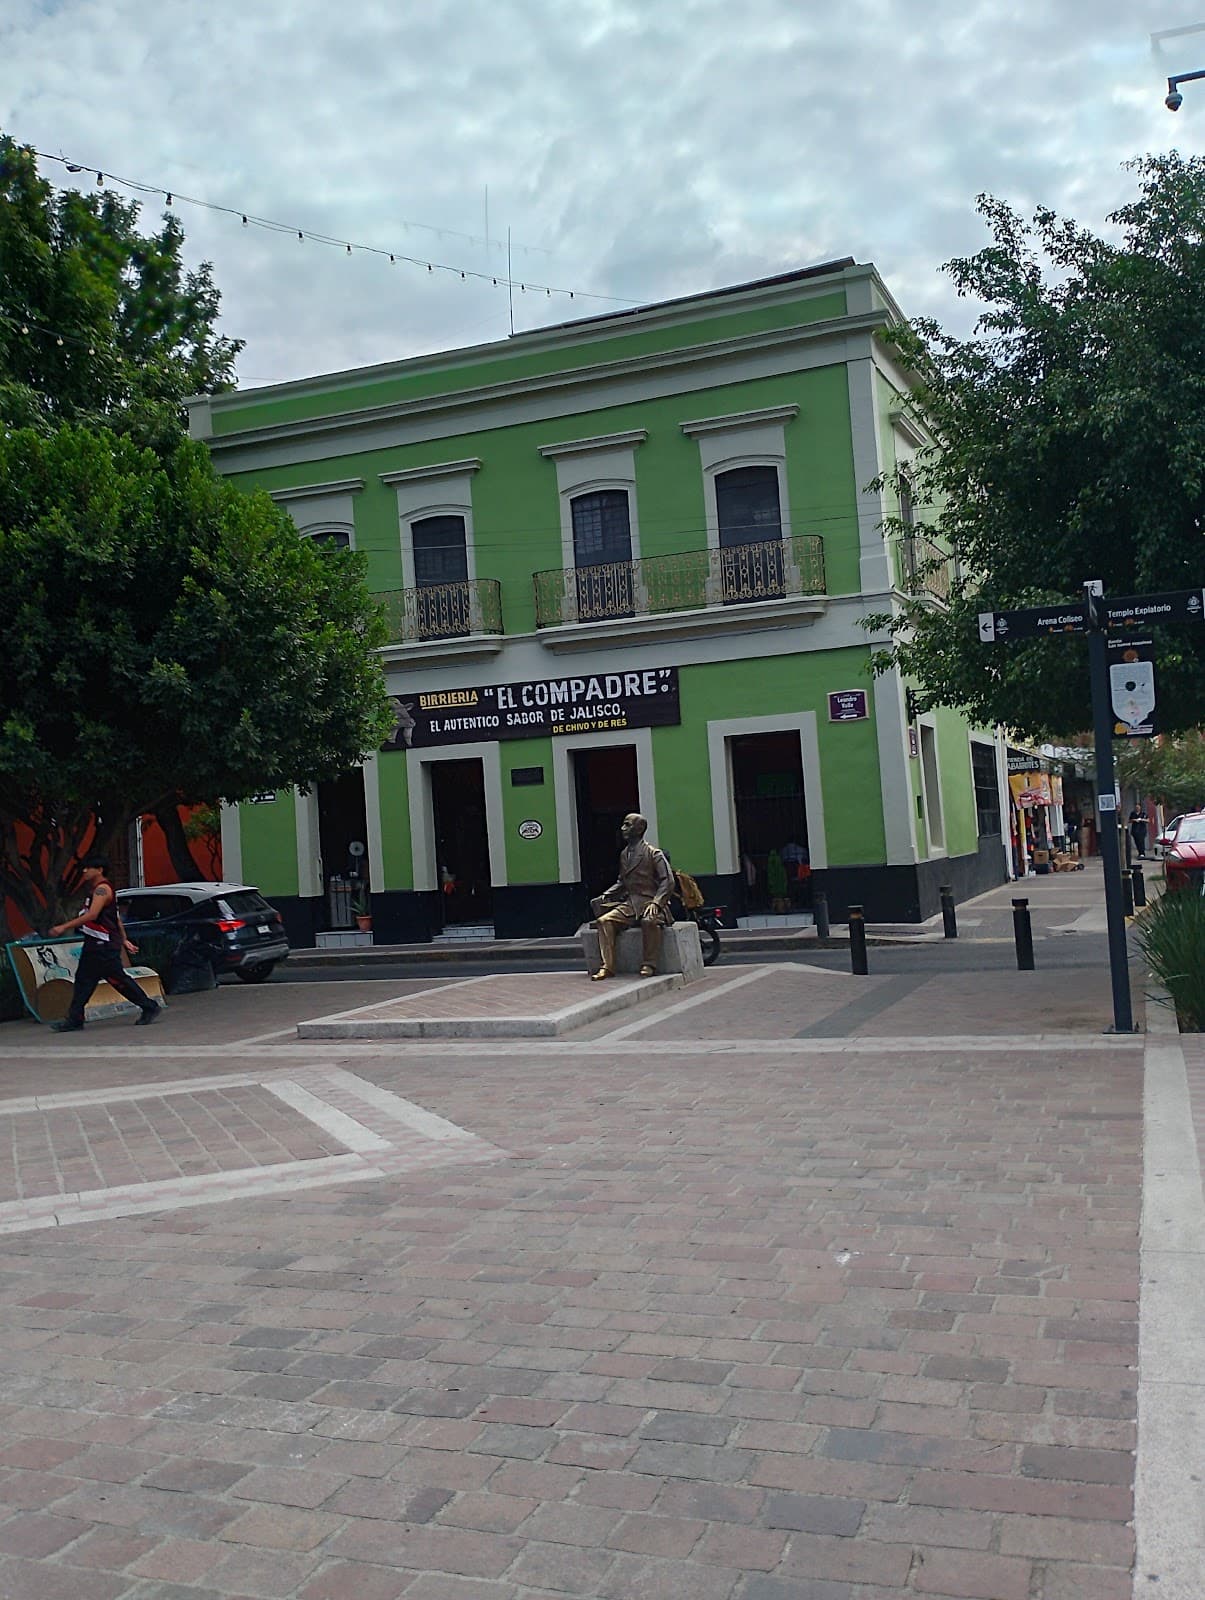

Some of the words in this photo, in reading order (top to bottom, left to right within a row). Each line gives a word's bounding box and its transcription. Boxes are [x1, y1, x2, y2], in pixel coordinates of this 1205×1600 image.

[1107, 608, 1134, 618] Templo
[1135, 604, 1171, 615] Expiatorio
[1037, 617, 1057, 626] Arena
[1058, 615, 1083, 624] Coliseo
[420, 690, 478, 707] BIRRIERIA
[430, 720, 441, 733] EL
[444, 716, 499, 731] AUTENTICO
[506, 710, 544, 726] SABOR
[550, 709, 565, 722] DE
[570, 703, 626, 720] JALISCO,
[553, 725, 564, 733] DE
[566, 721, 589, 731] CHIVO
[592, 721, 597, 729] Y
[598, 719, 608, 728] DE
[611, 718, 627, 727] RES
